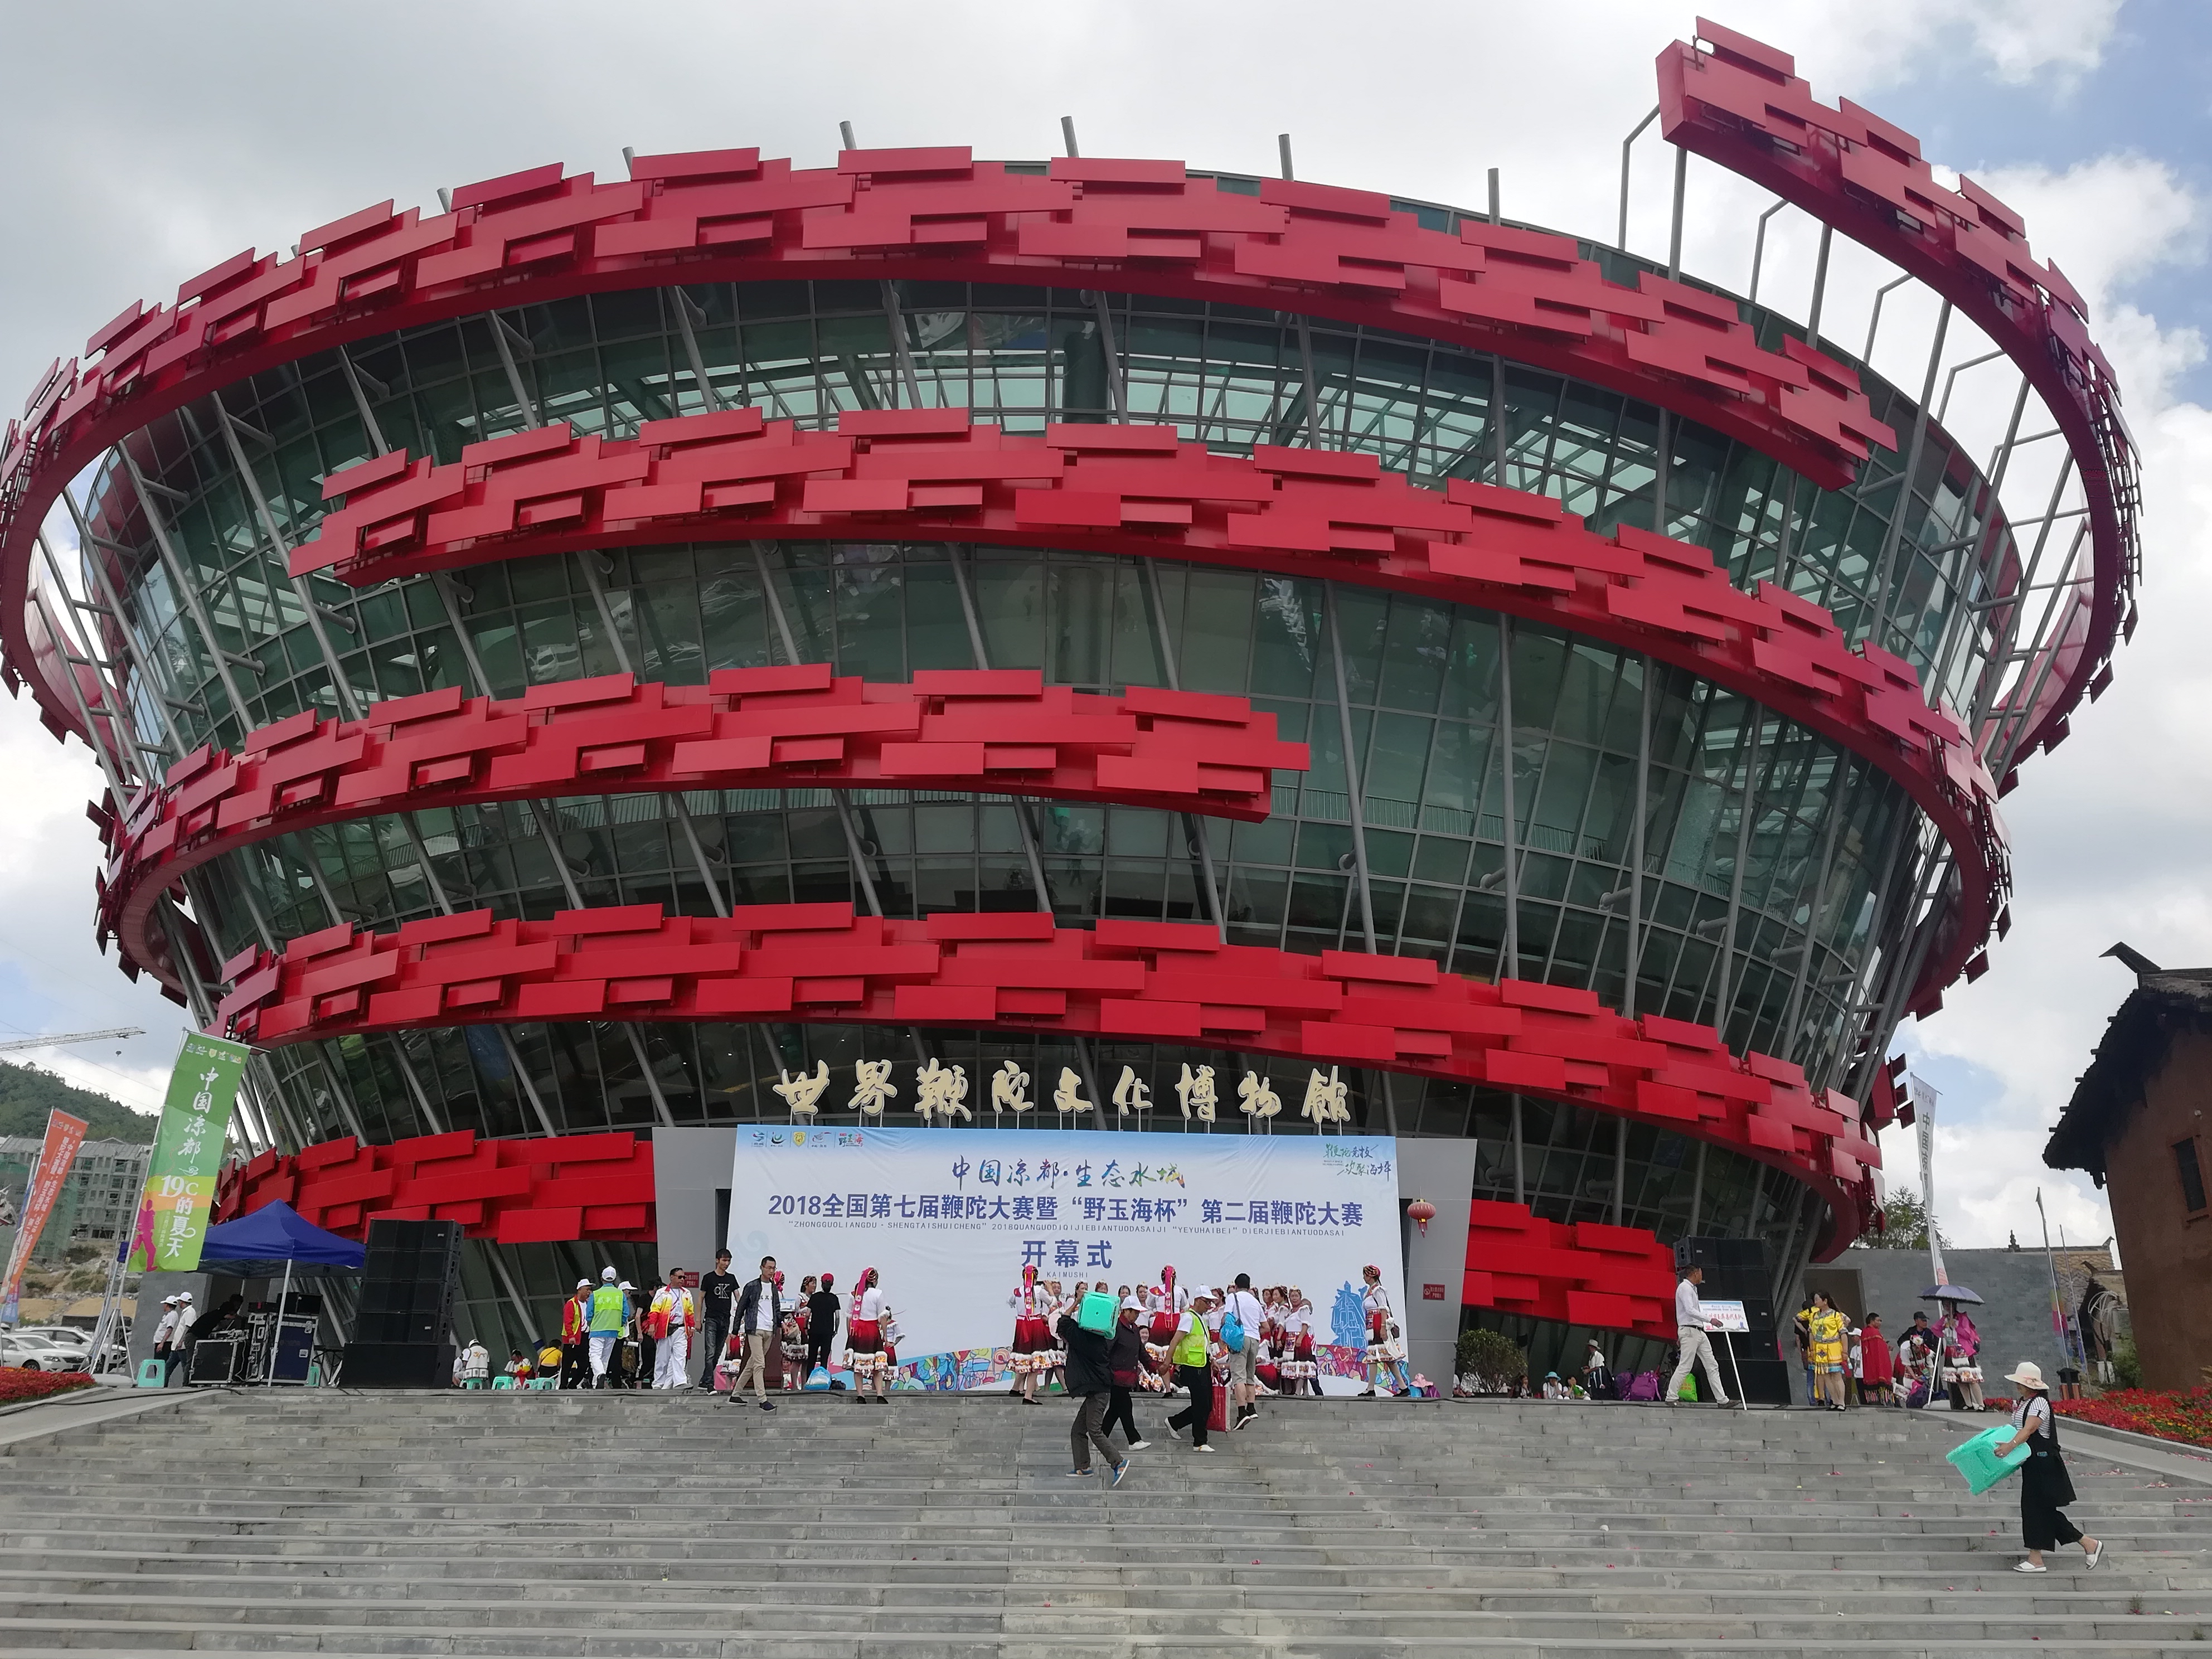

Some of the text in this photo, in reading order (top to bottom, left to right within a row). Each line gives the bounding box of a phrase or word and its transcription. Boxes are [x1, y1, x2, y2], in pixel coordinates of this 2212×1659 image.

[178, 1066, 219, 1164] 中国凉都
[1242, 1228, 1344, 1236] DIERJIEBIANTUODASAI
[1021, 1239, 1113, 1269] 开幕式
